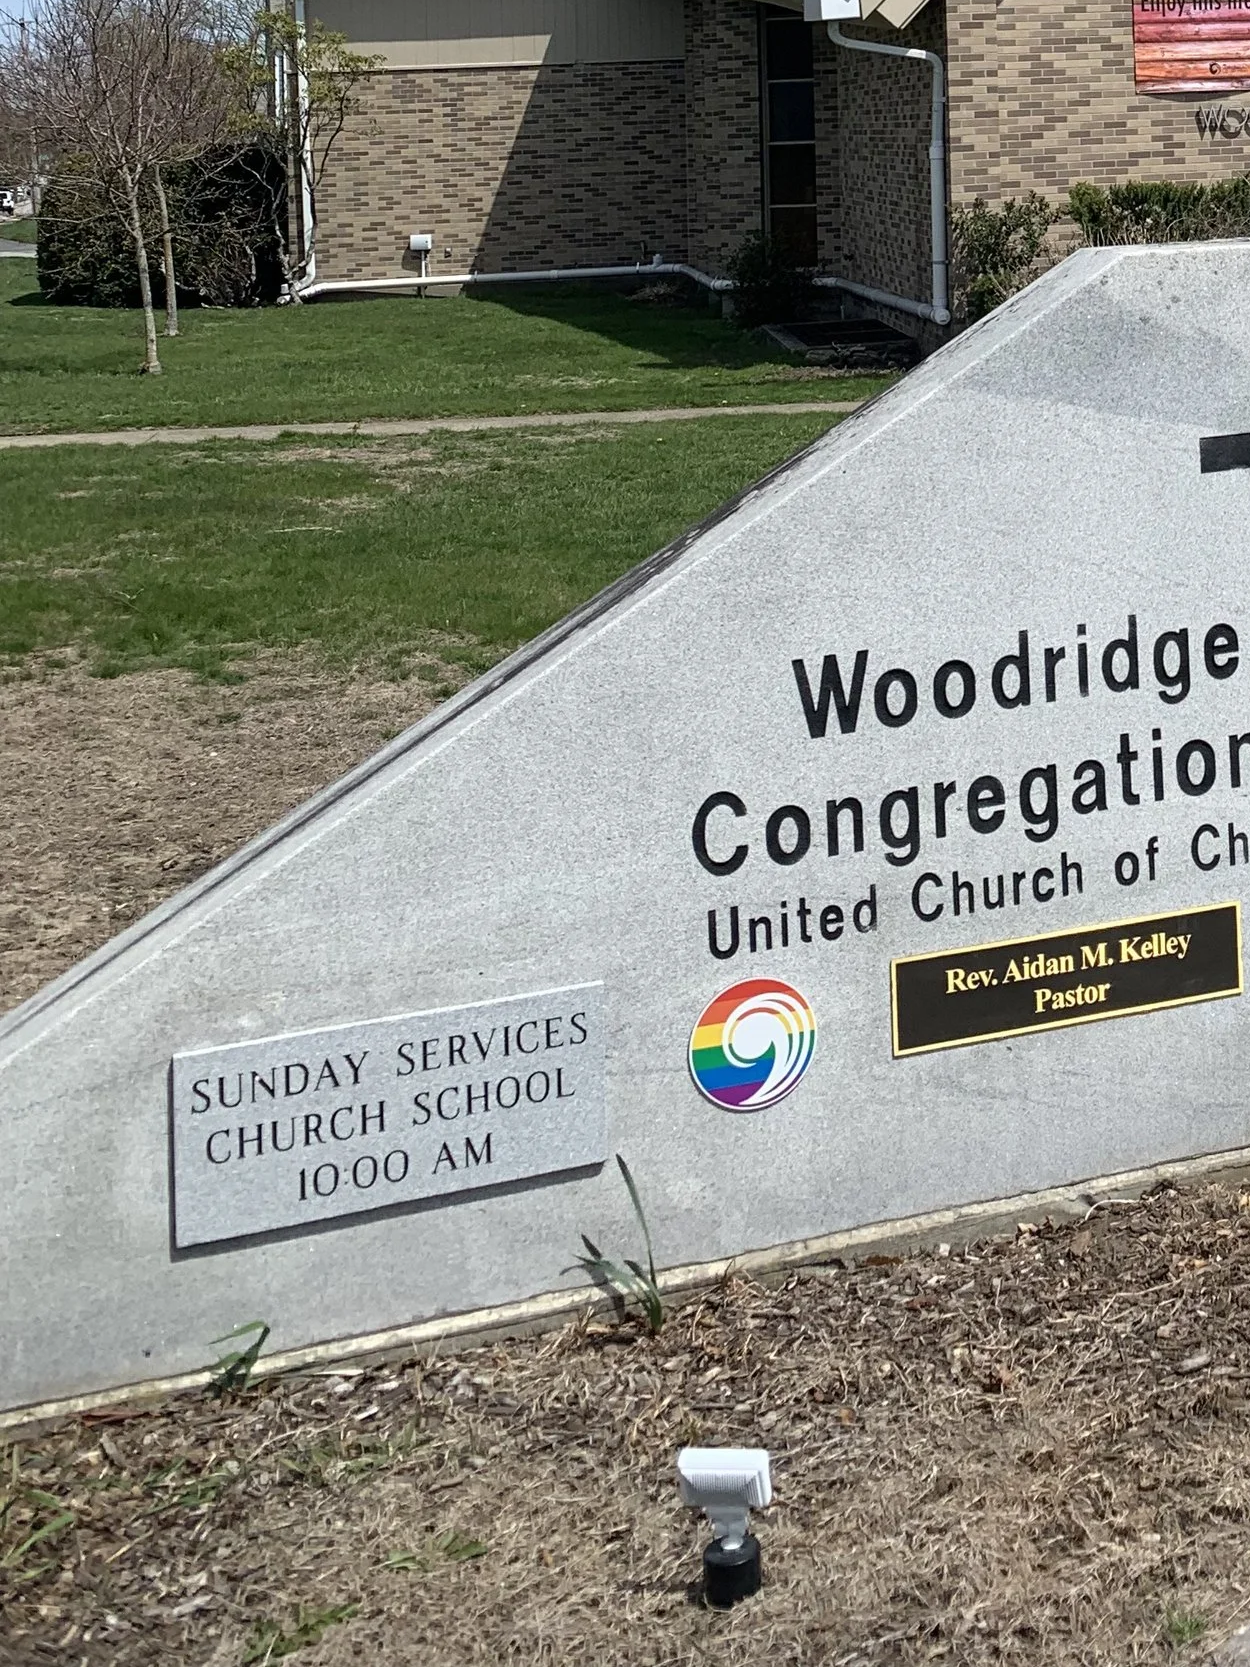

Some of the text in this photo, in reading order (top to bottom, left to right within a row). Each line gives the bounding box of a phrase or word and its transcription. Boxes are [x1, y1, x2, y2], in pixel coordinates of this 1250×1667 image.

[791, 614, 1240, 739] Woodridge
[707, 884, 878, 960] United
[911, 852, 1084, 923] Church
[1114, 837, 1160, 886] of
[945, 932, 1192, 994] Rev. Aidan M. Kelley
[1034, 981, 1112, 1014] Pastor
[191, 1012, 588, 1115] SUNDAY SERVICES
[206, 1067, 576, 1165] CHURCH SCHOOL
[298, 1133, 494, 1202] 10:00 AM
